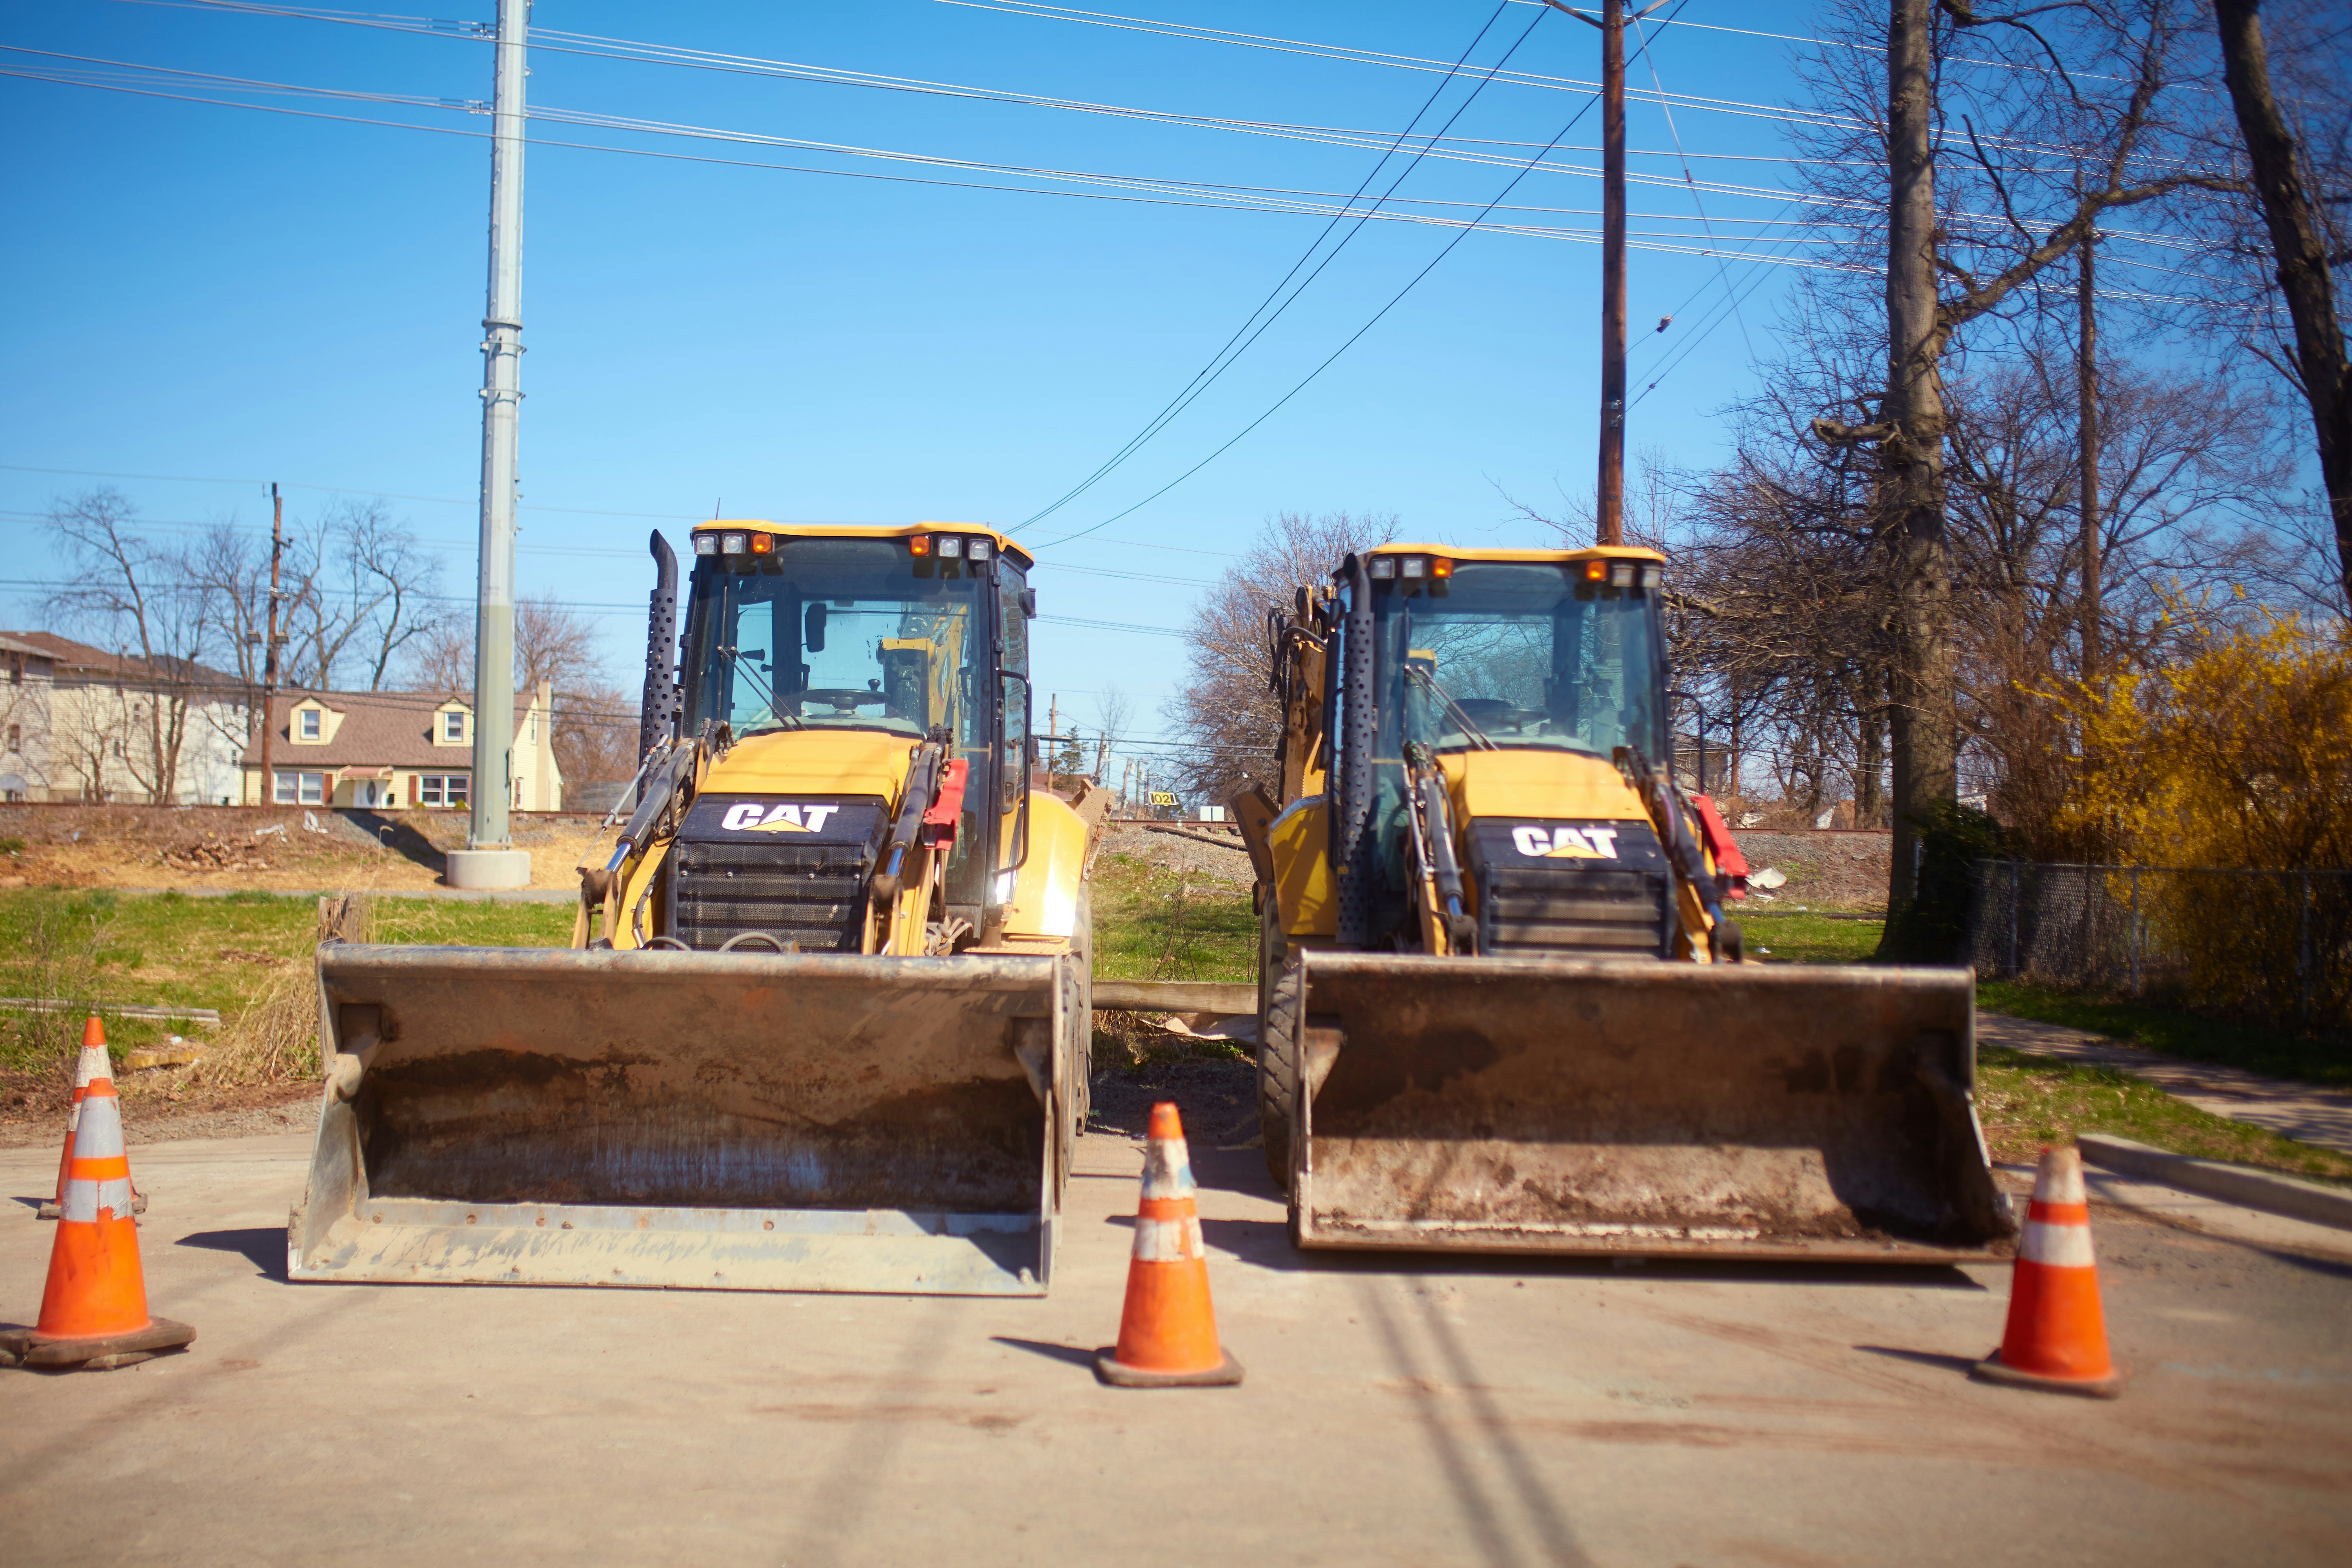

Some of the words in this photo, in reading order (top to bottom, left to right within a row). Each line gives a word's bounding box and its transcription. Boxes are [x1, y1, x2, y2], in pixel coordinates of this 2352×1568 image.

[1154, 794, 1170, 803] 02
[722, 803, 839, 832] CAT
[1512, 826, 1618, 858] CAT
